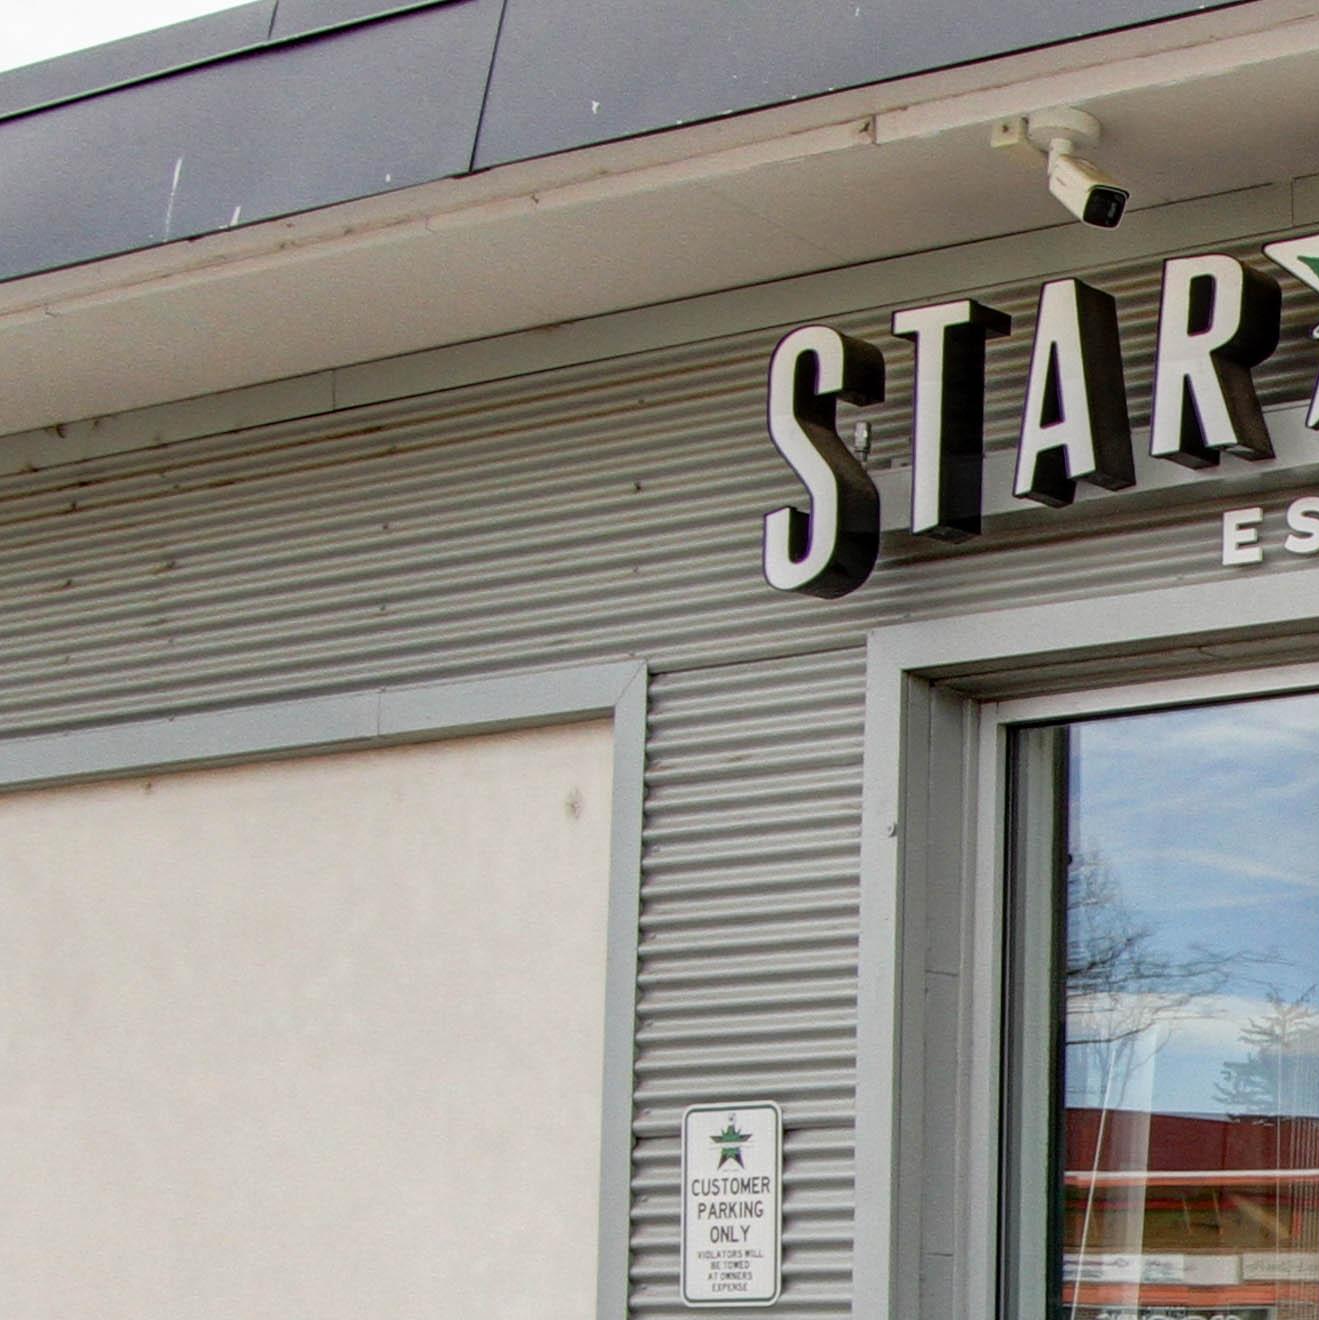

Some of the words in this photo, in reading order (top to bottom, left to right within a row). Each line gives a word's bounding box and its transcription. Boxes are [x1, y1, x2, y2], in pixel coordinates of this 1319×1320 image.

[763, 253, 1262, 596] STAR
[691, 1176, 770, 1197] CUSTOMER
[697, 1200, 764, 1221] PARKING
[709, 1225, 751, 1243] ONLY
